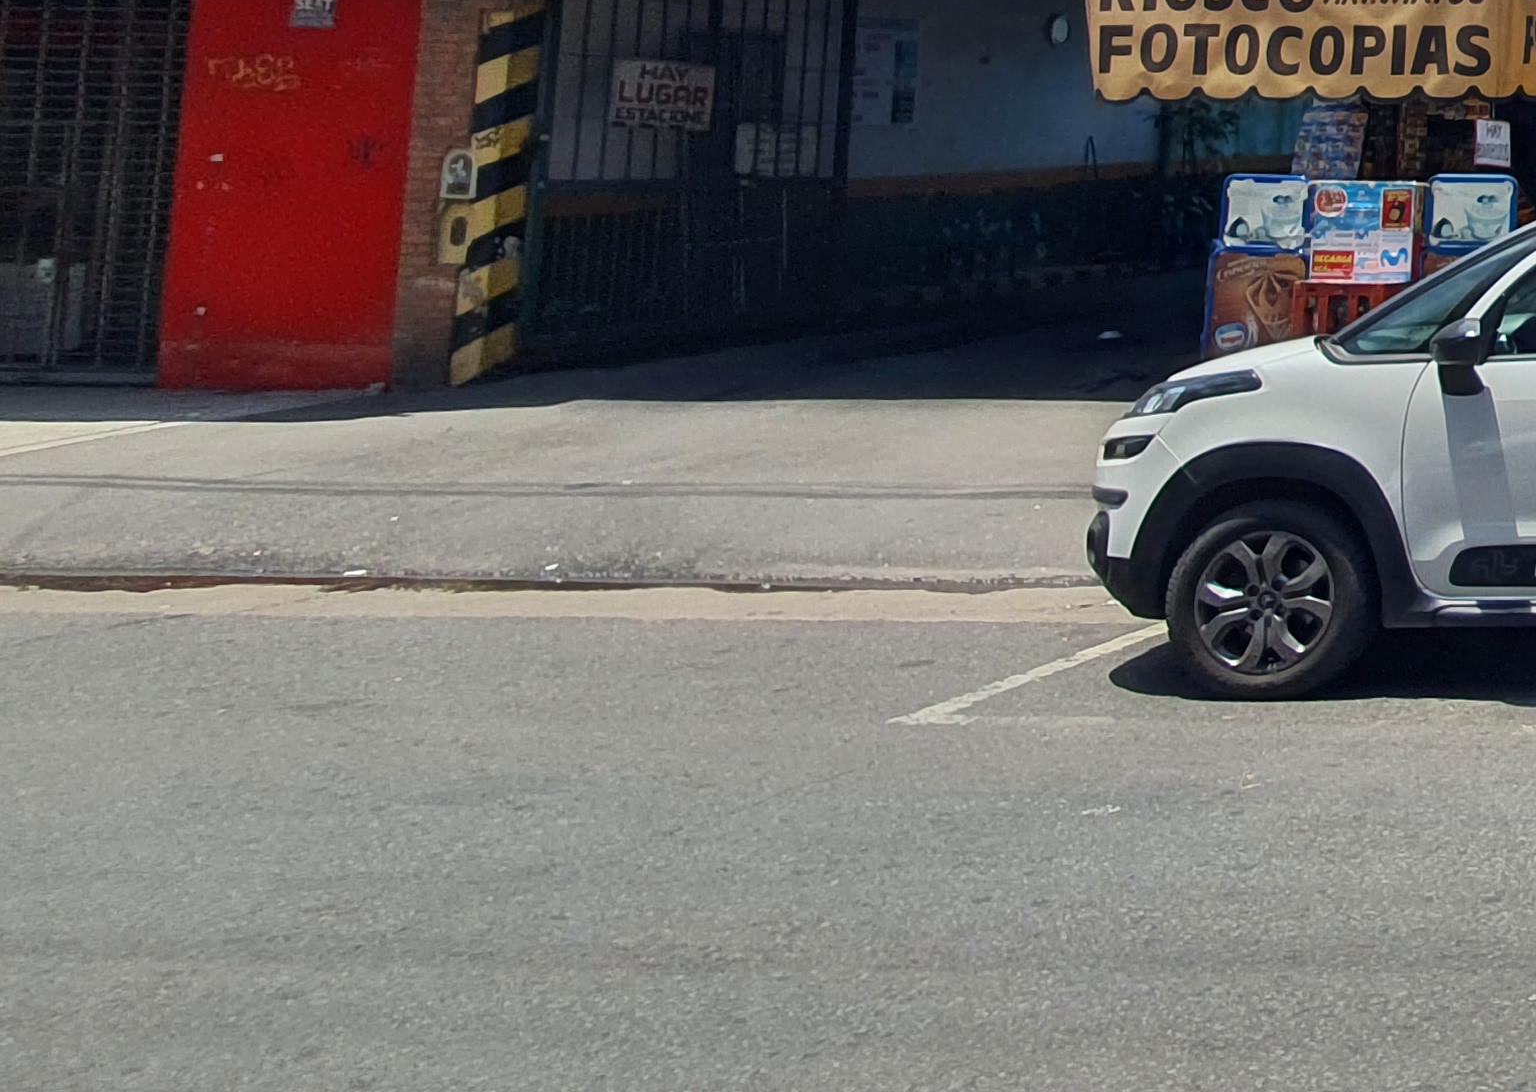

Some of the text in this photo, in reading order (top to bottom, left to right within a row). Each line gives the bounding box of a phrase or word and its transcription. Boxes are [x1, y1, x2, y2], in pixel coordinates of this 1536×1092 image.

[1098, 22, 1492, 77] FOTOCOPIAS
[640, 64, 689, 81] HAY
[618, 80, 709, 107] LUGAR
[614, 107, 706, 124] ESTACIONE
